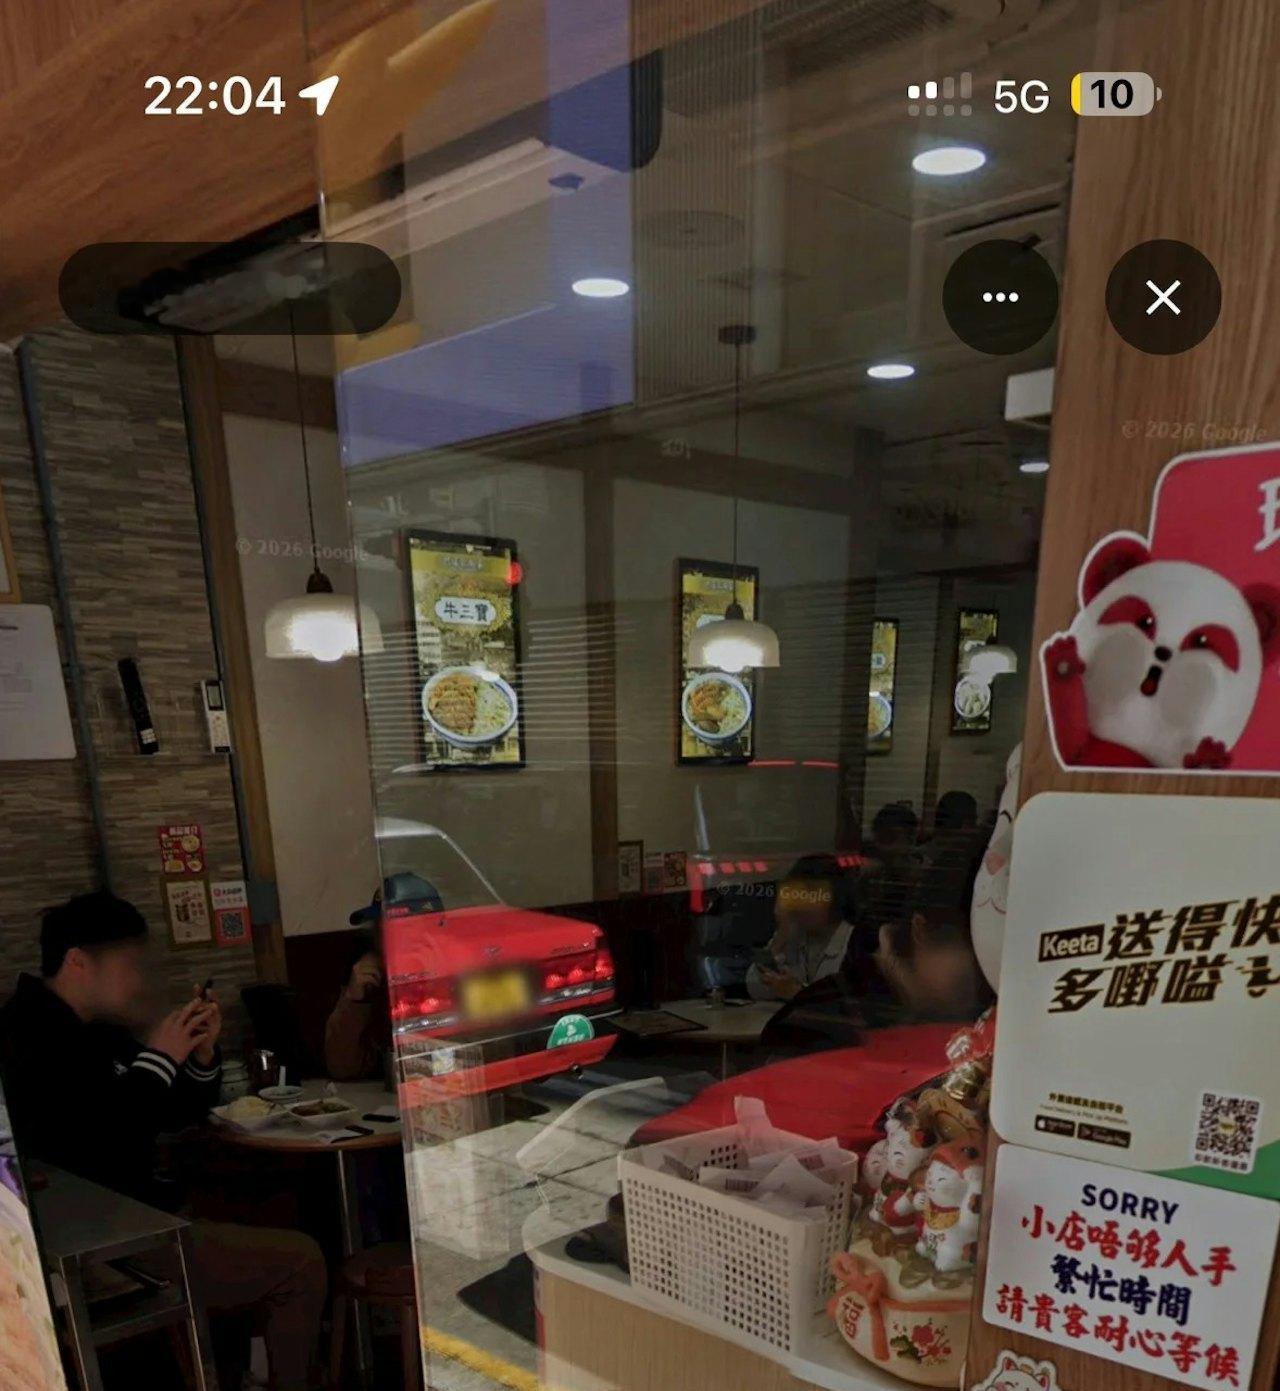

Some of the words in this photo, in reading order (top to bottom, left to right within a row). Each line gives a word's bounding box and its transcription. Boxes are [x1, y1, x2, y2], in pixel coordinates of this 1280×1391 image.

[443, 601, 489, 622] 牛三寶
[1041, 930, 1101, 959] Keeta
[1103, 894, 1280, 961] 送得快
[1081, 1184, 1179, 1225] SORRY
[1050, 1253, 1192, 1327] 繁忙時間
[995, 1283, 1240, 1388] 請貴客耐心等候
